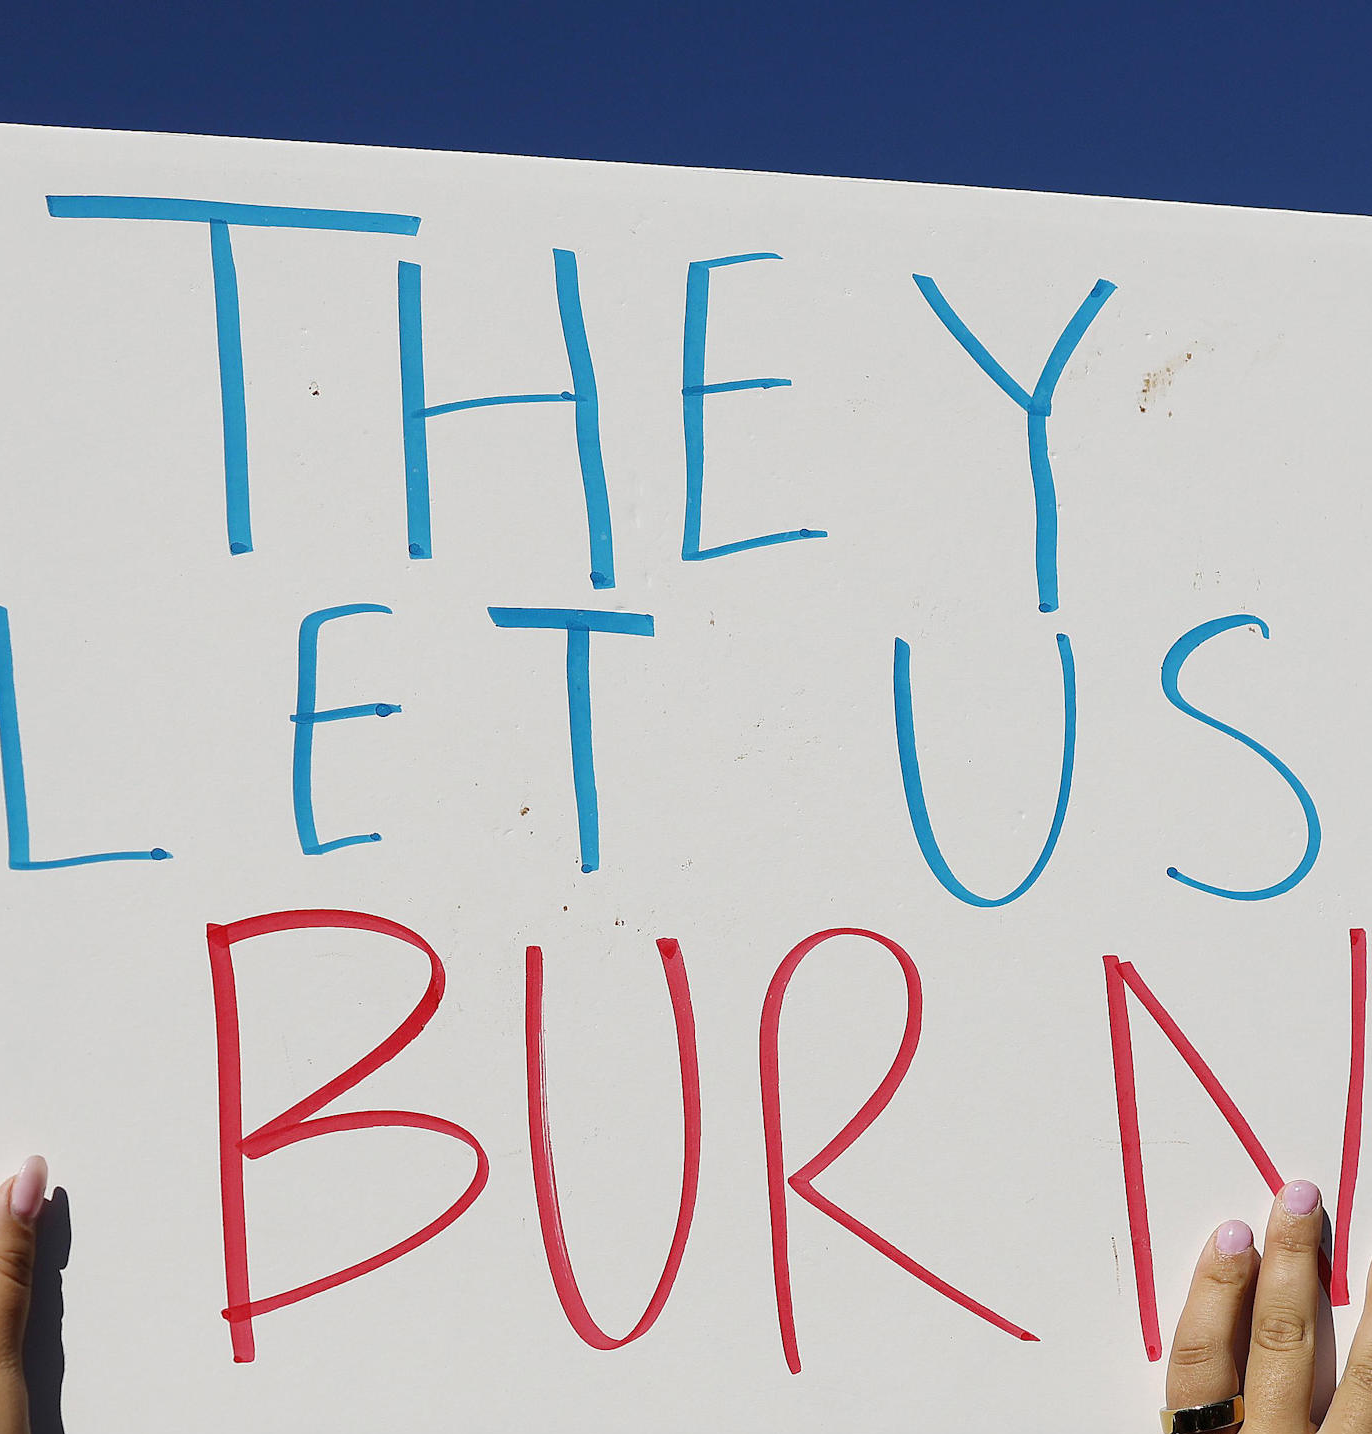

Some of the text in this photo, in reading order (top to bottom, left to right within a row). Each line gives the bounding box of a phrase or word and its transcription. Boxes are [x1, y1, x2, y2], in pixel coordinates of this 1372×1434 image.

[45, 194, 1118, 614] THEY
[892, 613, 1323, 909] US
[205, 907, 1367, 1375] BURN
